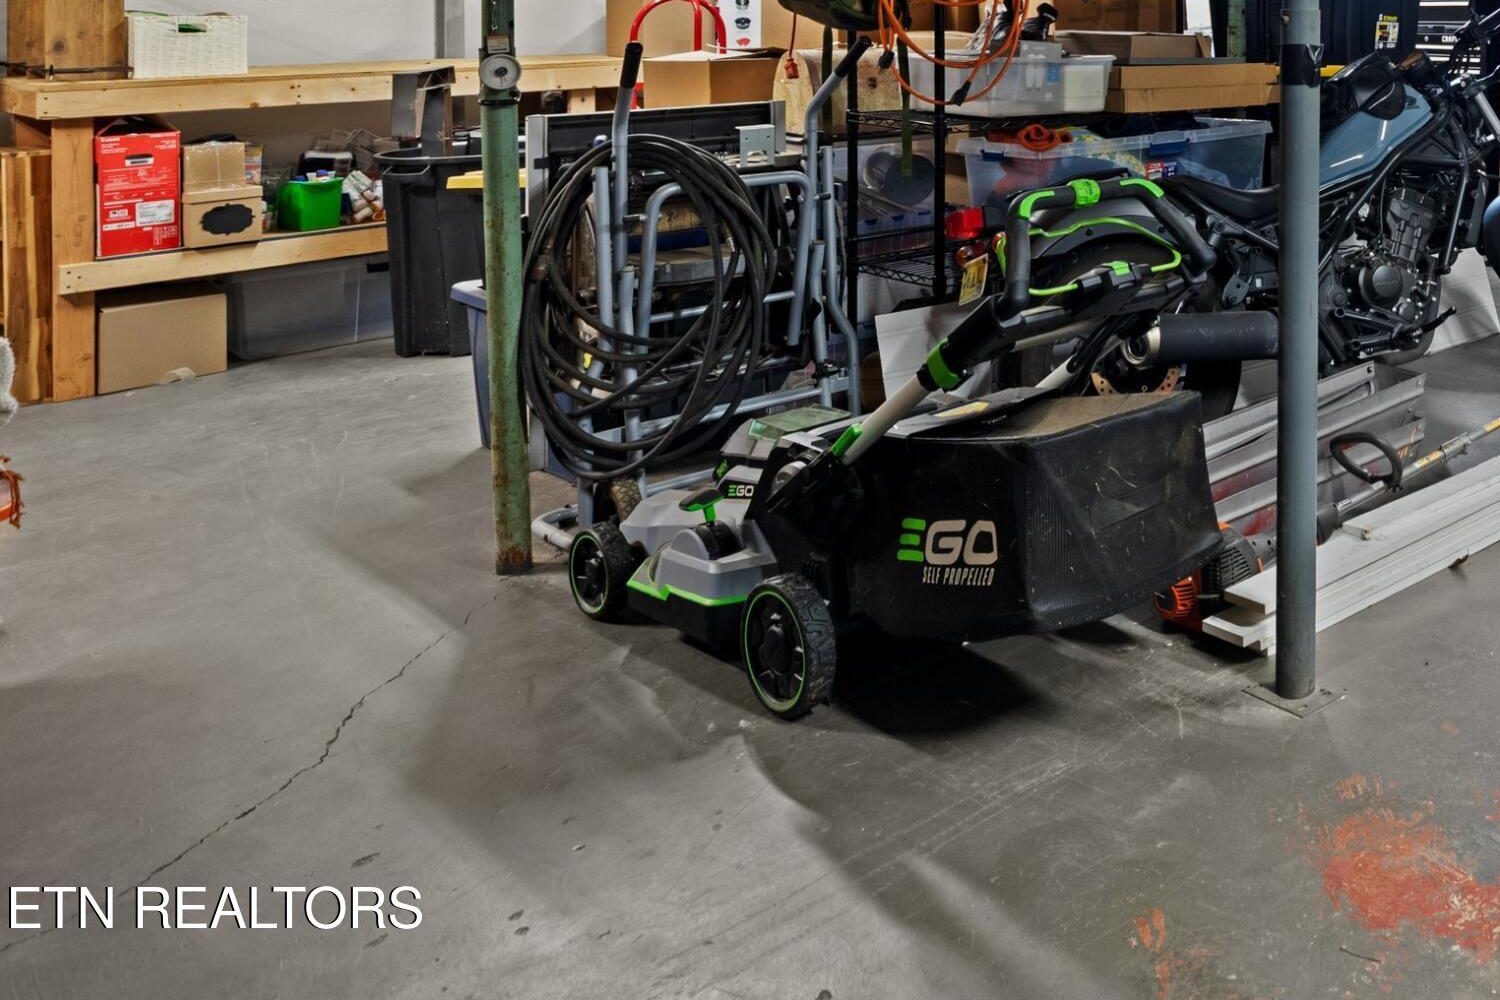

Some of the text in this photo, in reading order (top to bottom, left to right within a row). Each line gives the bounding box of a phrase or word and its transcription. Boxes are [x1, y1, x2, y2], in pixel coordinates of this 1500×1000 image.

[728, 485, 754, 497] EGO
[897, 518, 998, 565] EGO
[922, 566, 995, 586] SELF PROPELLED
